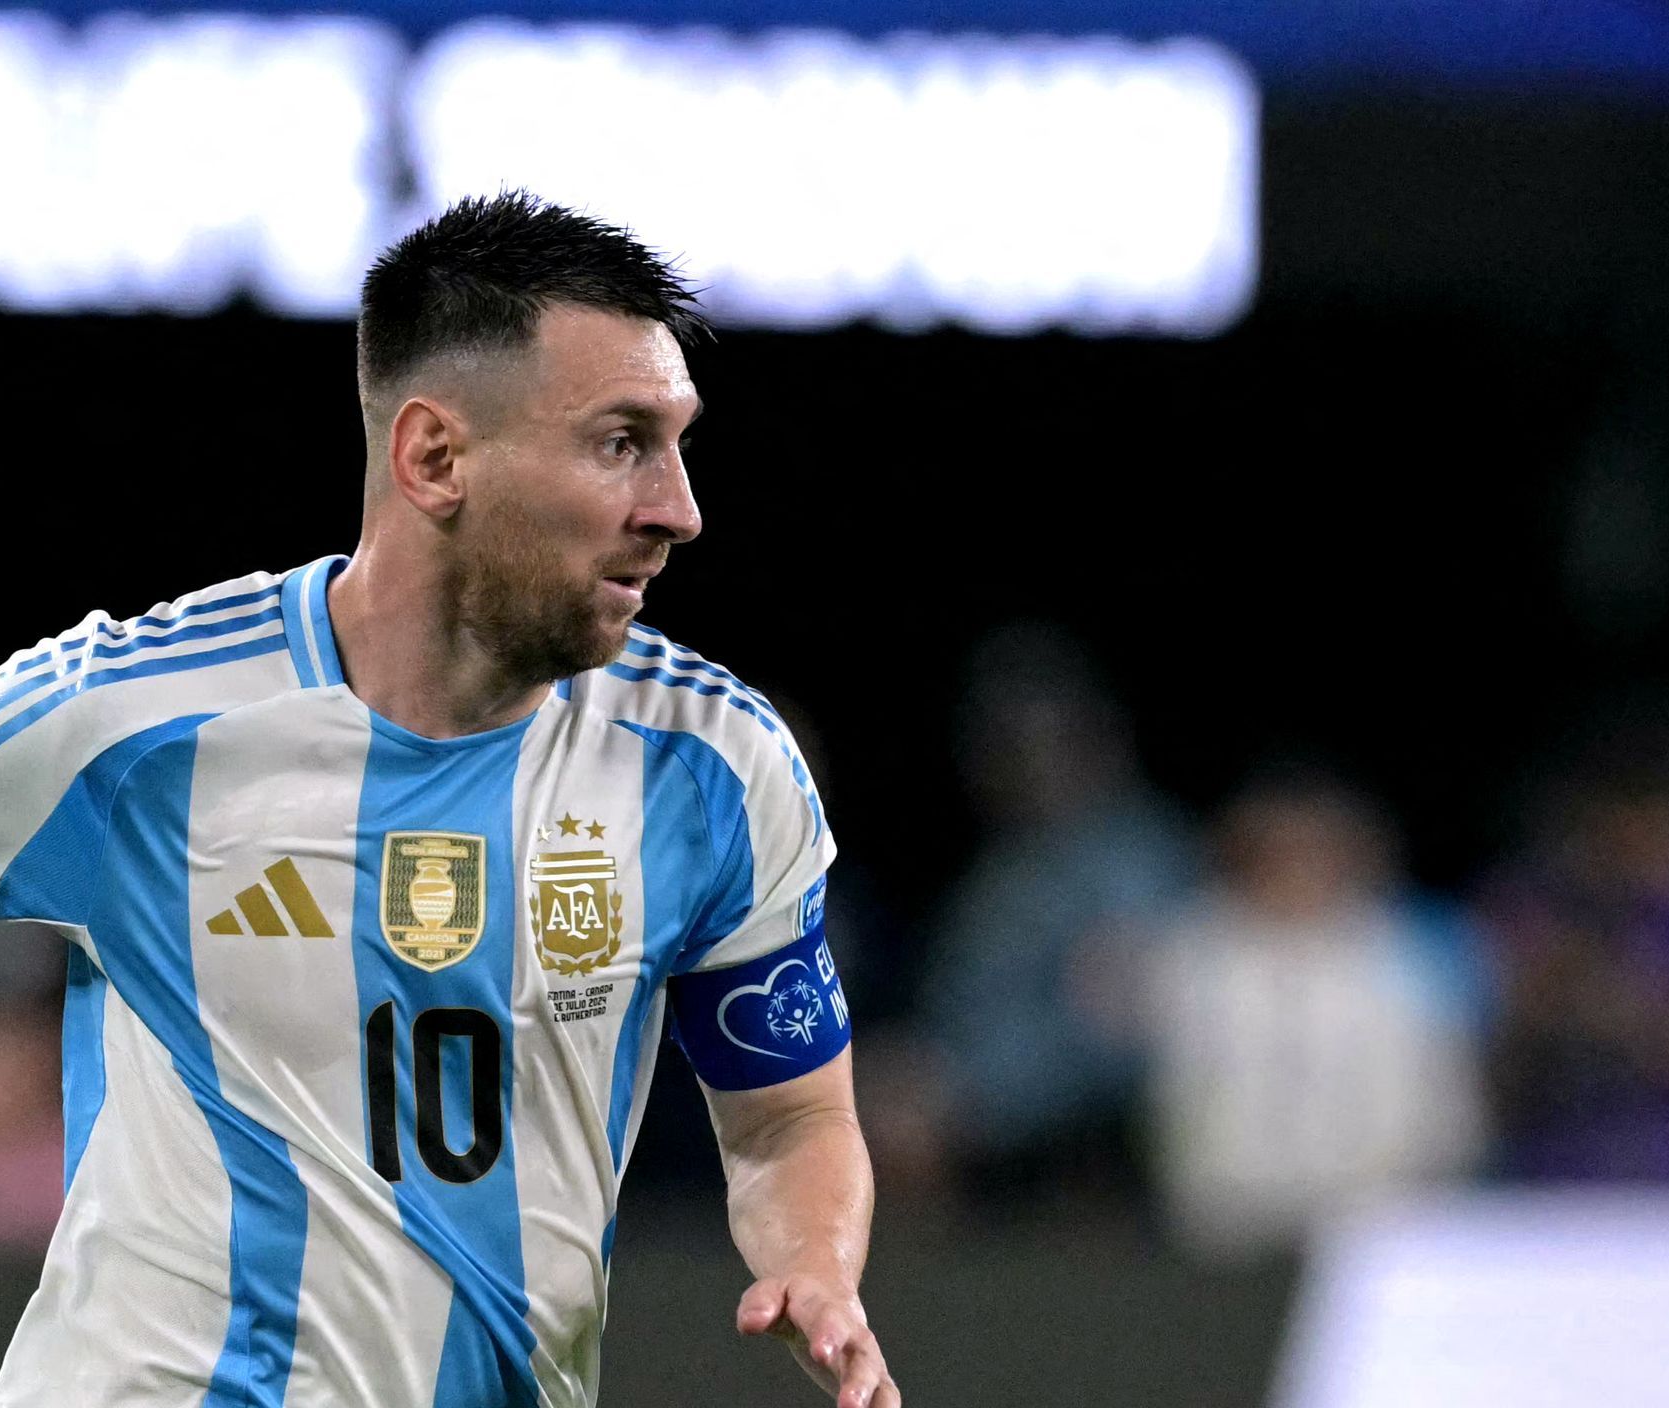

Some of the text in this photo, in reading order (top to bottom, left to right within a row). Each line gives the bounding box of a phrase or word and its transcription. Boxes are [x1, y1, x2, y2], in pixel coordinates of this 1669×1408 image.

[546, 883, 604, 940] AFA
[419, 949, 445, 958] 2021
[585, 983, 614, 997] CANADA
[565, 999, 587, 1011] JULIO
[588, 996, 607, 1008] 2024
[364, 1000, 504, 1184] 10
